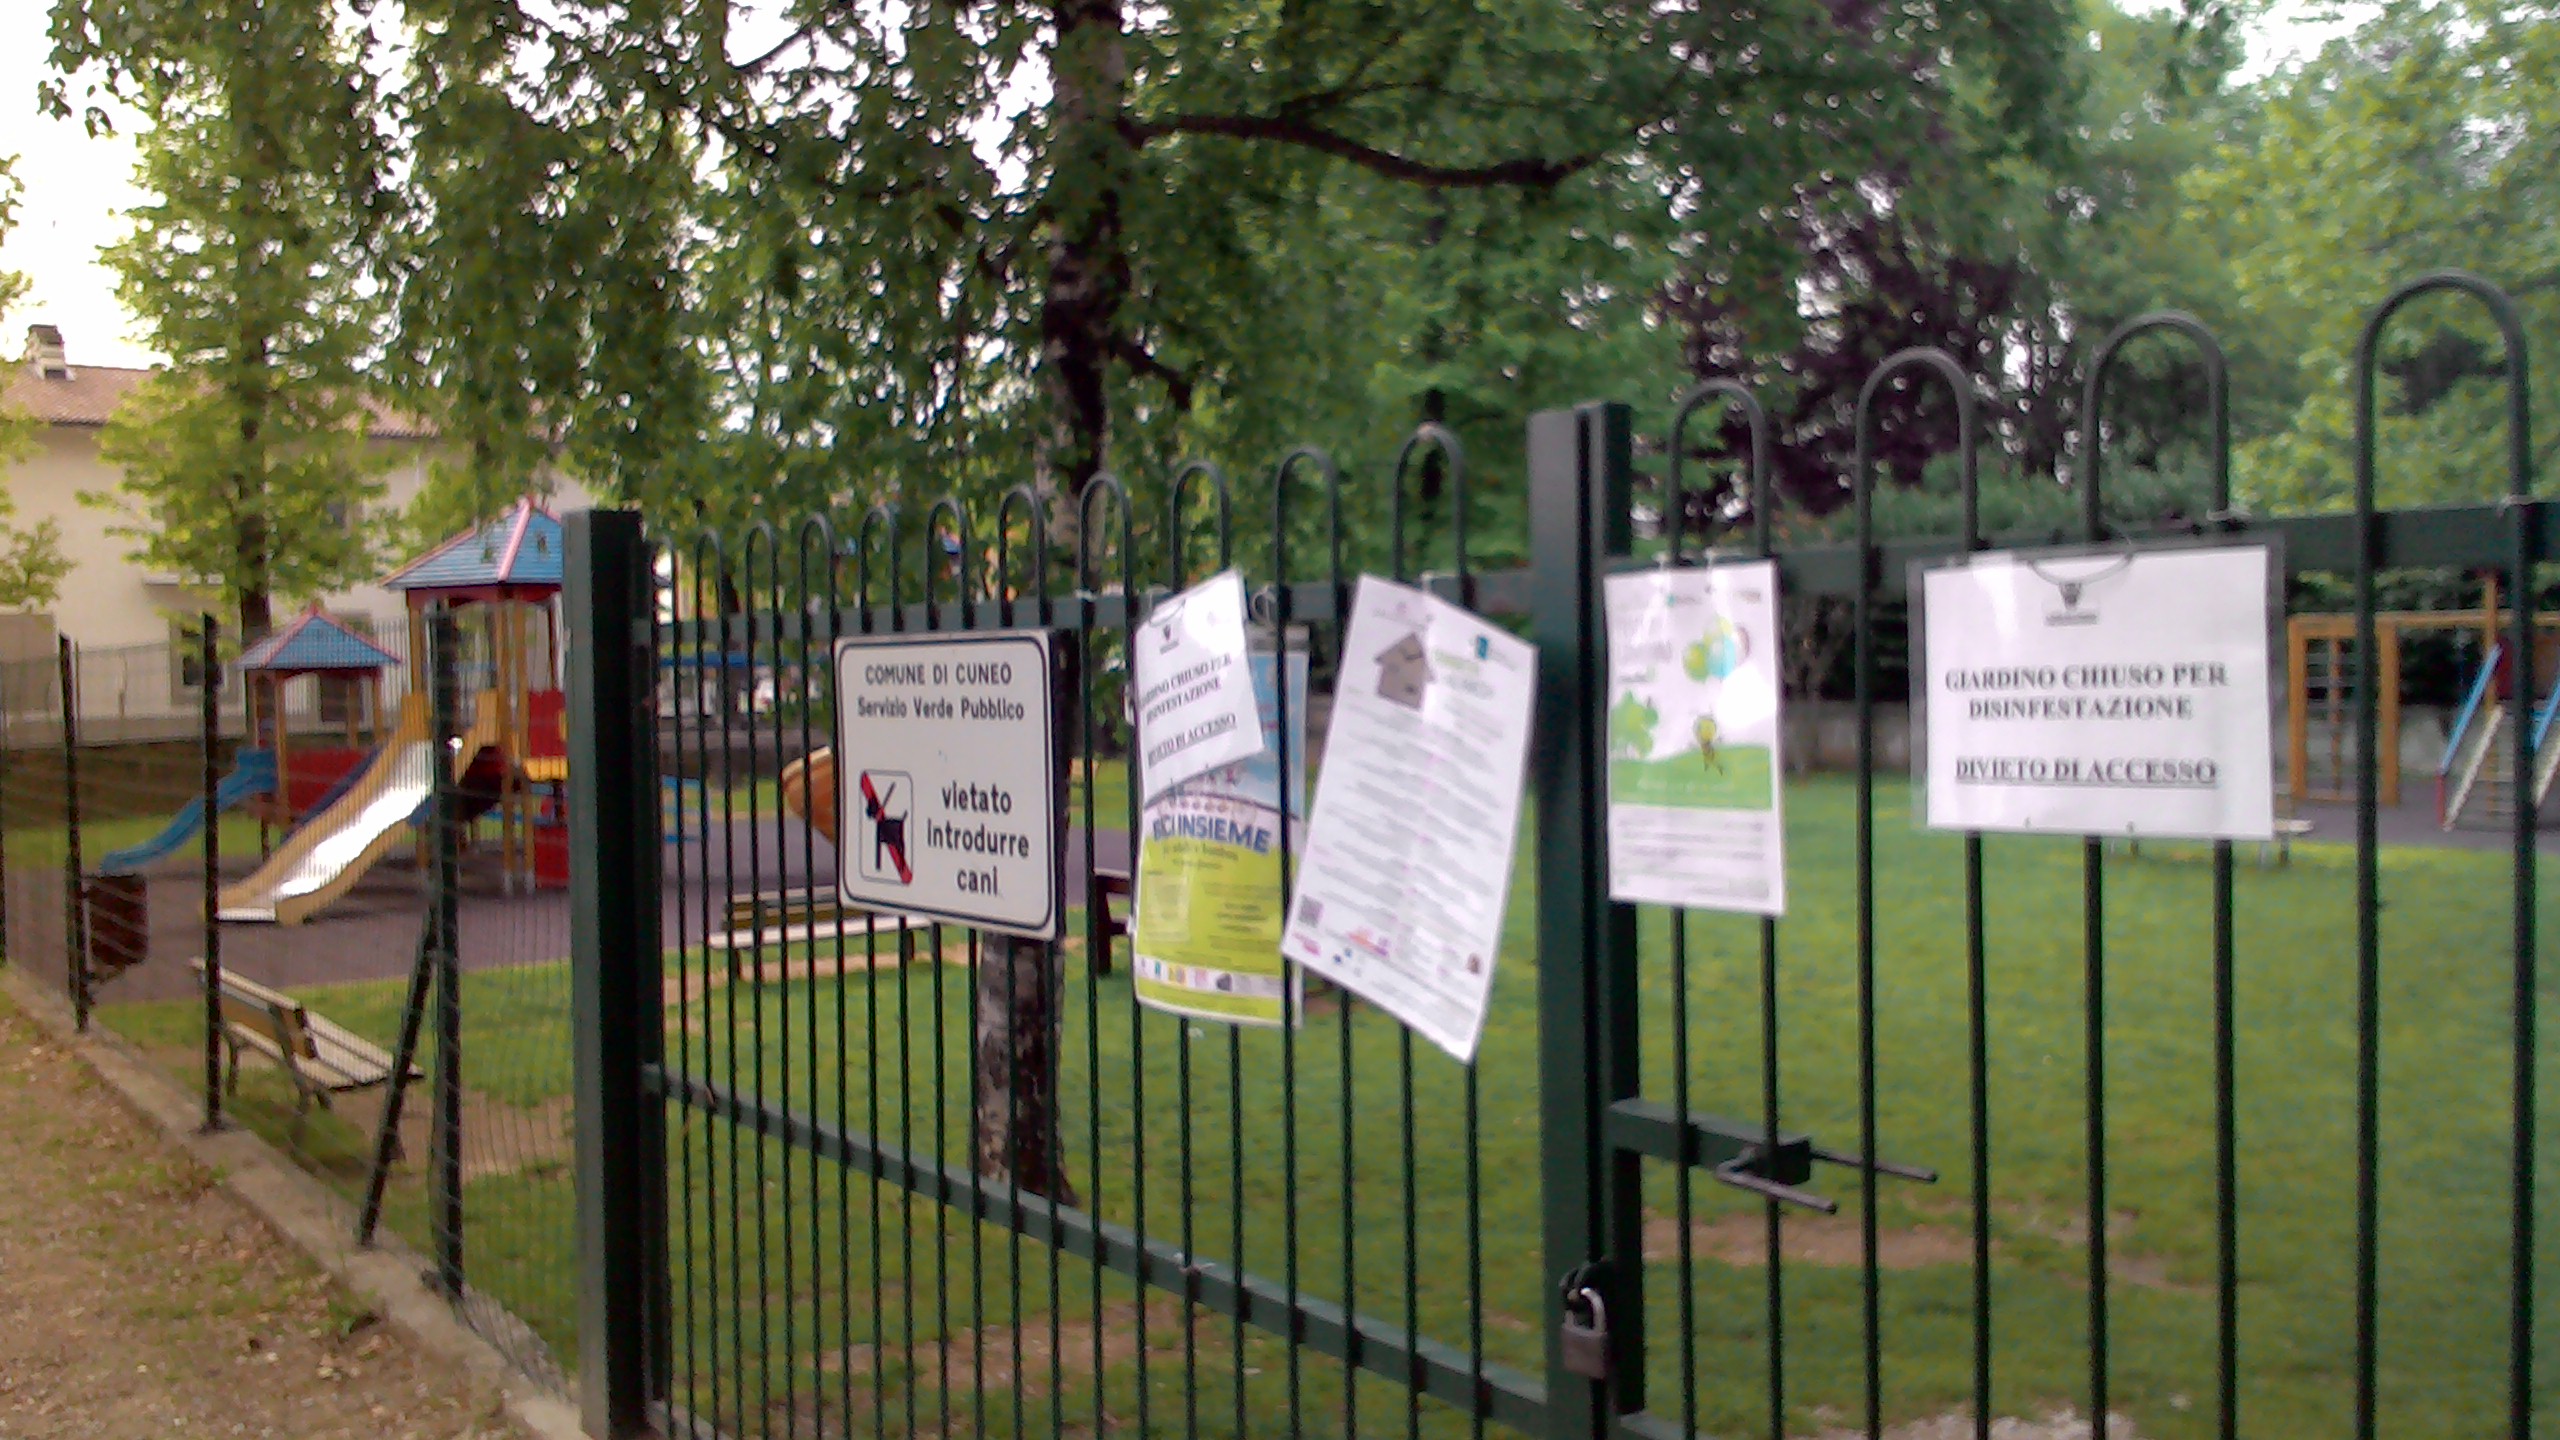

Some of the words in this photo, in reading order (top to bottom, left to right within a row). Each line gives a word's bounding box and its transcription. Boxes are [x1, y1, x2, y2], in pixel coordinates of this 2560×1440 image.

[864, 663, 926, 686] COMUNE
[932, 663, 949, 685] DI
[955, 662, 1013, 685] CUNEO
[1170, 662, 1210, 690] CHIUSO
[1945, 664, 2056, 692] GIARDINO
[2061, 662, 2165, 690] CHIUSO
[2171, 661, 2229, 688] PER
[857, 695, 908, 719] Servizio
[913, 697, 954, 719] Verde
[960, 697, 1025, 721] Pubblico
[1968, 697, 2194, 721] DISINFESTAZIONE
[1955, 756, 2047, 783] DIVIETO
[2053, 758, 2080, 783] DI
[2085, 757, 2219, 787] ACCESSO
[941, 780, 1012, 814] vietato
[926, 819, 1030, 858] introdurre
[956, 866, 999, 897] cani
